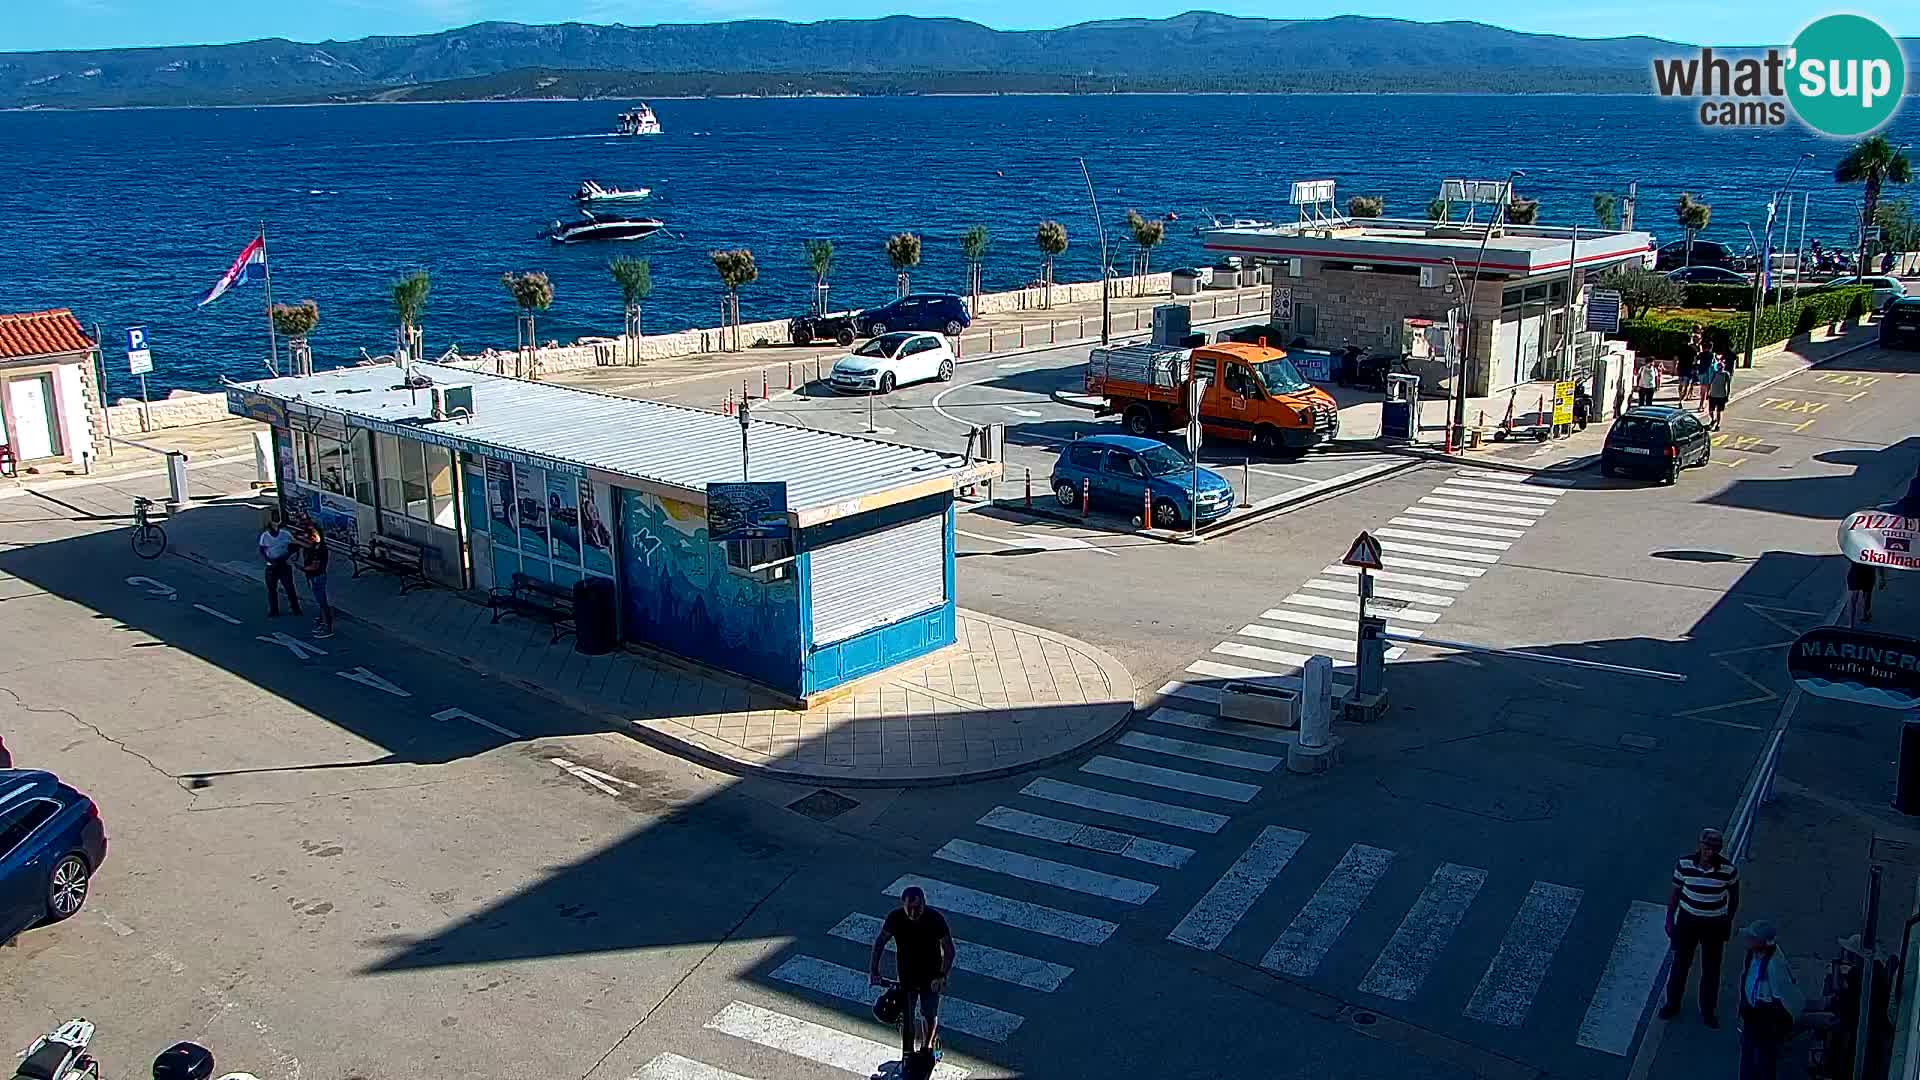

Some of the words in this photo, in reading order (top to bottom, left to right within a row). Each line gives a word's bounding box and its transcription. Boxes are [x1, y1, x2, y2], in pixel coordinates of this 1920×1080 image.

[129, 329, 144, 349] P
[1815, 373, 1881, 387] TAXI
[1758, 397, 1830, 414] TAXI
[1710, 433, 1764, 450] AXI
[494, 448, 527, 464] STATION
[528, 456, 555, 470] TICKET
[556, 461, 583, 476] OFFICE
[1849, 514, 1920, 532] PIZZE
[1870, 665, 1898, 681] bar
